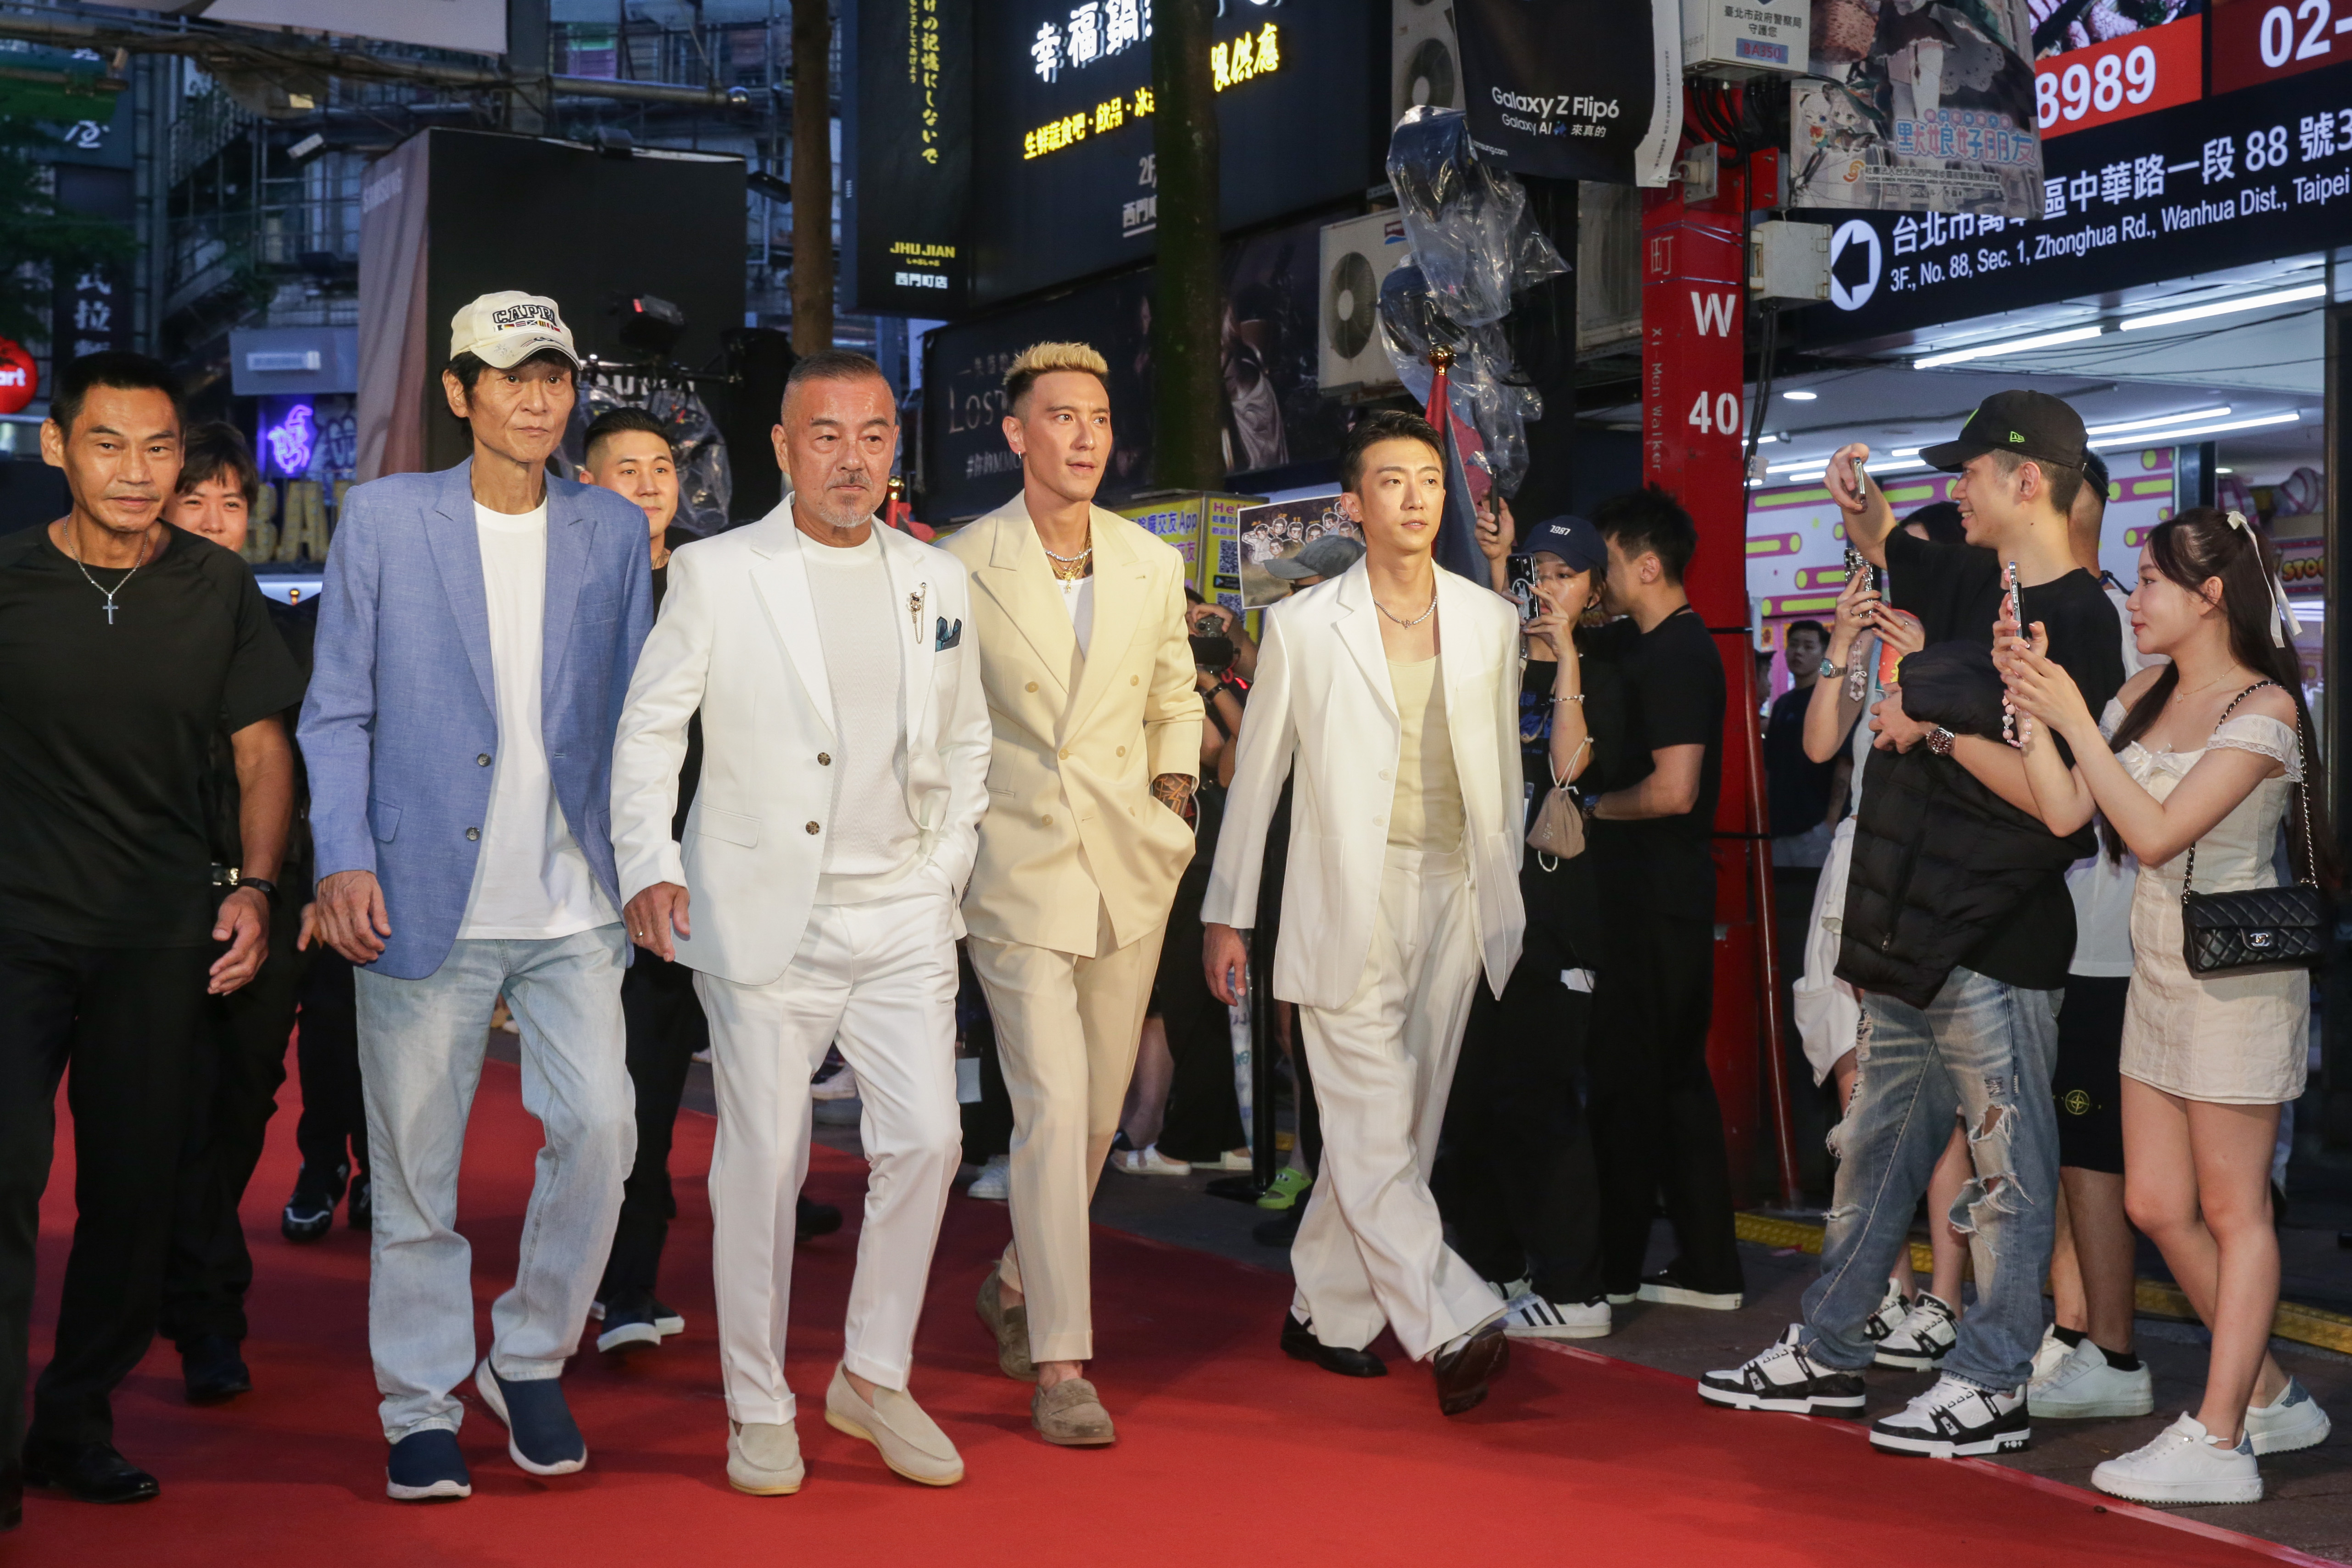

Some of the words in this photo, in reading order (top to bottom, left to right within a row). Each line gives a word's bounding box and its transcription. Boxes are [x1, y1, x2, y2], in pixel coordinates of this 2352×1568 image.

[1724, 6, 1802, 29] 臺北市政府警察局
[1748, 23, 1778, 38] 守護您
[1743, 42, 1782, 59] BA350
[1492, 86, 1554, 118] Galaxy
[1556, 95, 1569, 115] Z
[1572, 95, 1620, 123] Flip6
[2035, 45, 2156, 129] 8989
[1501, 113, 1537, 136] Galaxy
[1538, 121, 1552, 134] AI
[1571, 124, 1606, 137] 來真的
[1896, 121, 2034, 164] 默娘好朋友
[2245, 125, 2289, 172] 88
[1890, 266, 1916, 292] 3F.,
[1920, 261, 1945, 285] No.
[1950, 253, 1973, 279] 88,
[1977, 248, 2012, 273] Sec.
[2016, 239, 2031, 266] 1,
[2034, 224, 2117, 257] Zhonghua
[2122, 212, 2157, 239] Rd.,
[2161, 199, 2235, 232] Wanhua
[2240, 185, 2287, 216] Dist.,
[2292, 167, 2350, 205] Taipei
[895, 272, 948, 289] 西門町店
[1690, 291, 1737, 337] W
[1689, 391, 1739, 435] 40
[1652, 405, 1663, 473] Walker
[1549, 525, 1571, 536] 1987
